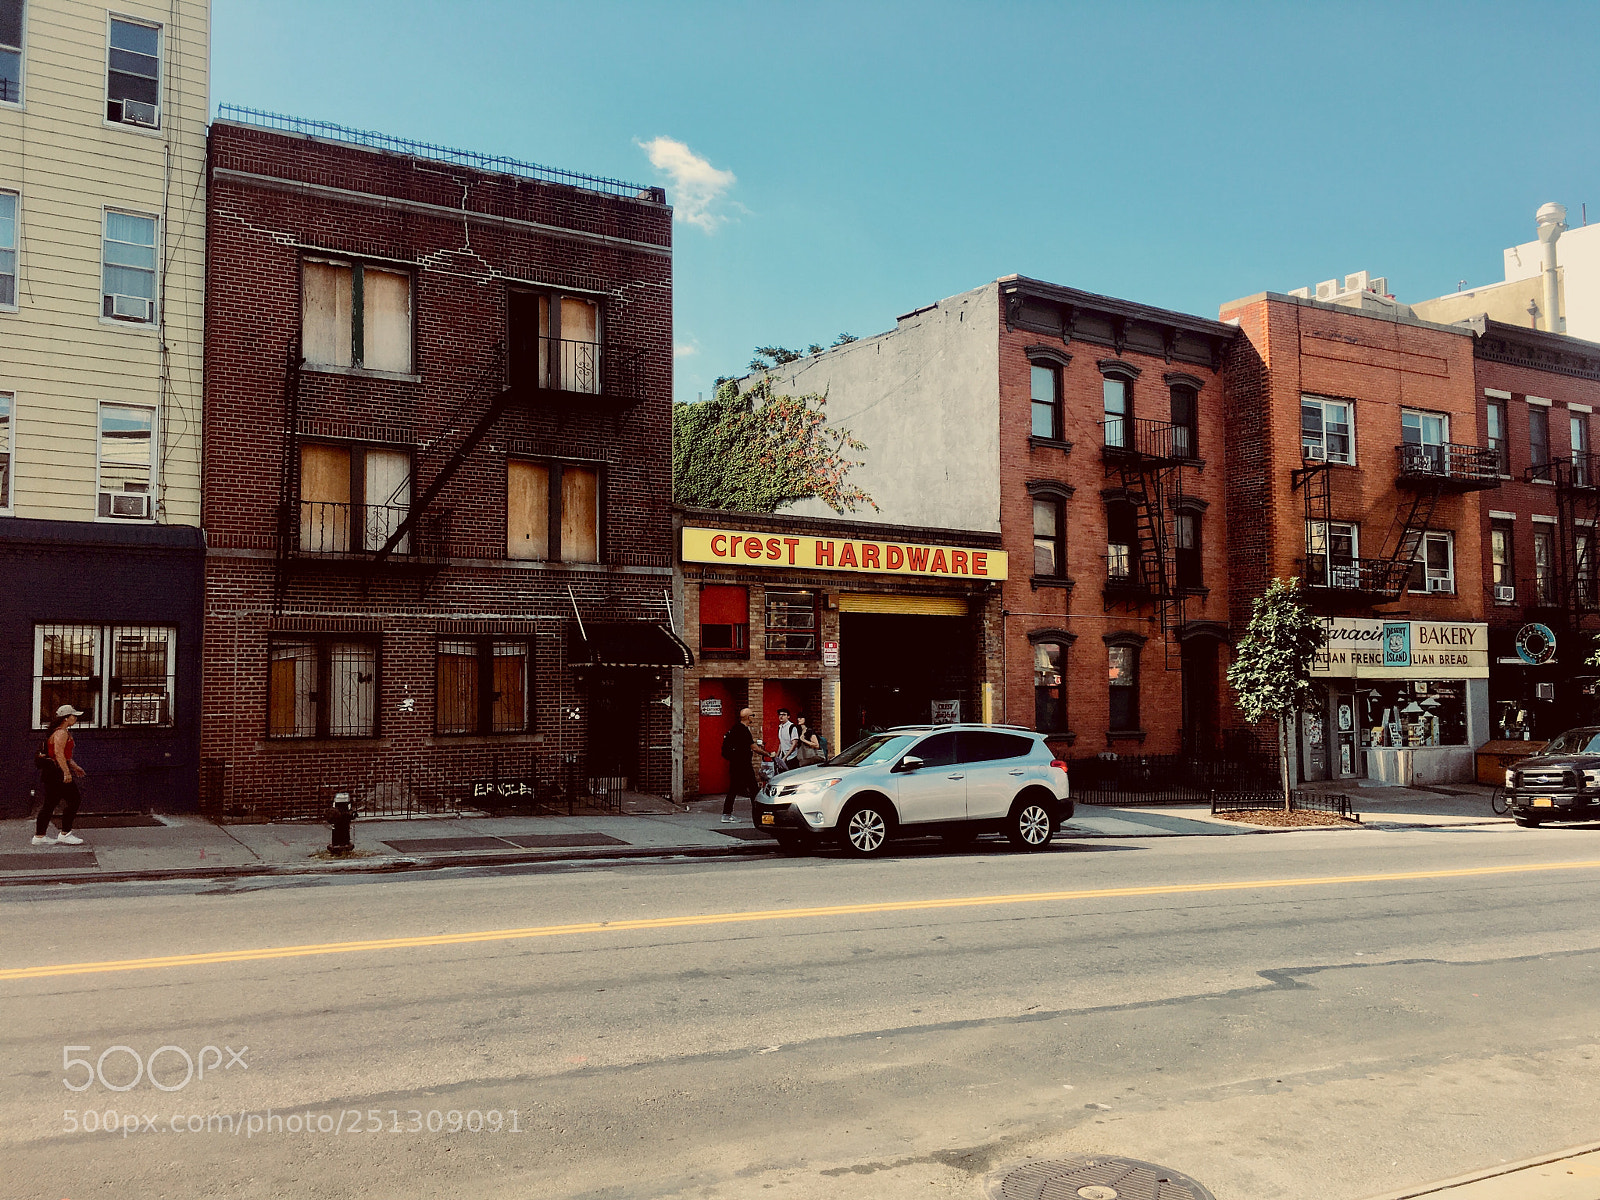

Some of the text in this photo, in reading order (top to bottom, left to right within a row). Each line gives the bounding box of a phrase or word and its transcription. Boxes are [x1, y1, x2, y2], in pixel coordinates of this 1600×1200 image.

[815, 541, 989, 576] HARDWARE
[1321, 625, 1477, 645] araci BAKERY
[1386, 627, 1406, 639] DESERT
[1315, 652, 1346, 664] ALIAN
[1411, 653, 1434, 665] LIAN
[1439, 654, 1468, 665] BREAD
[1386, 651, 1408, 662] ISLAND
